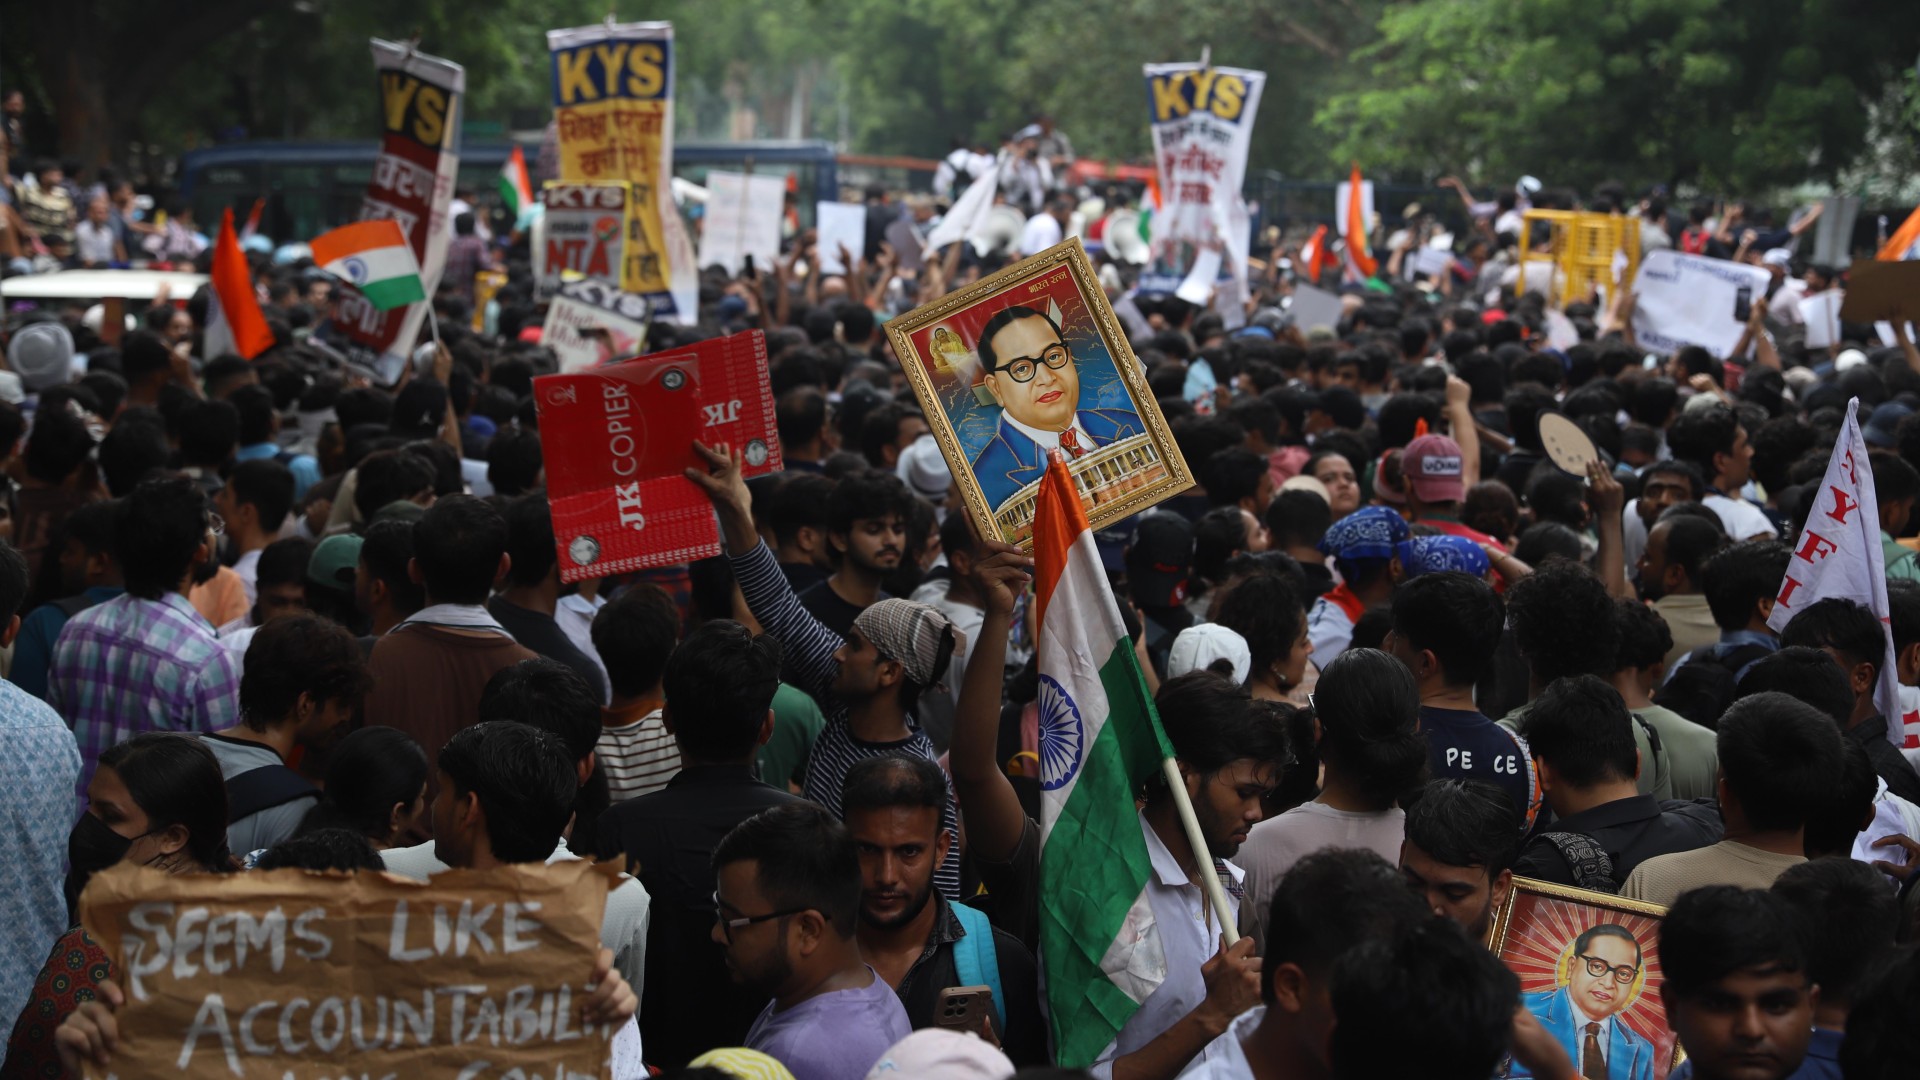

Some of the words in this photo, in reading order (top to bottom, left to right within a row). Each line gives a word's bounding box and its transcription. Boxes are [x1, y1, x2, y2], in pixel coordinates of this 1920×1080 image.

[558, 42, 664, 104] KYS
[1152, 69, 1247, 121] KYS
[549, 185, 621, 207] KYS
[545, 239, 610, 277] NTA
[562, 279, 647, 319] KYS
[1028, 278, 1050, 294] भारत
[603, 383, 638, 477] COPIER
[703, 399, 743, 428] JK
[612, 481, 645, 532] JK
[1446, 747, 1473, 770] PE
[1493, 755, 1518, 775] CE
[121, 901, 334, 1001] SEEMS
[388, 897, 544, 962] LIKE
